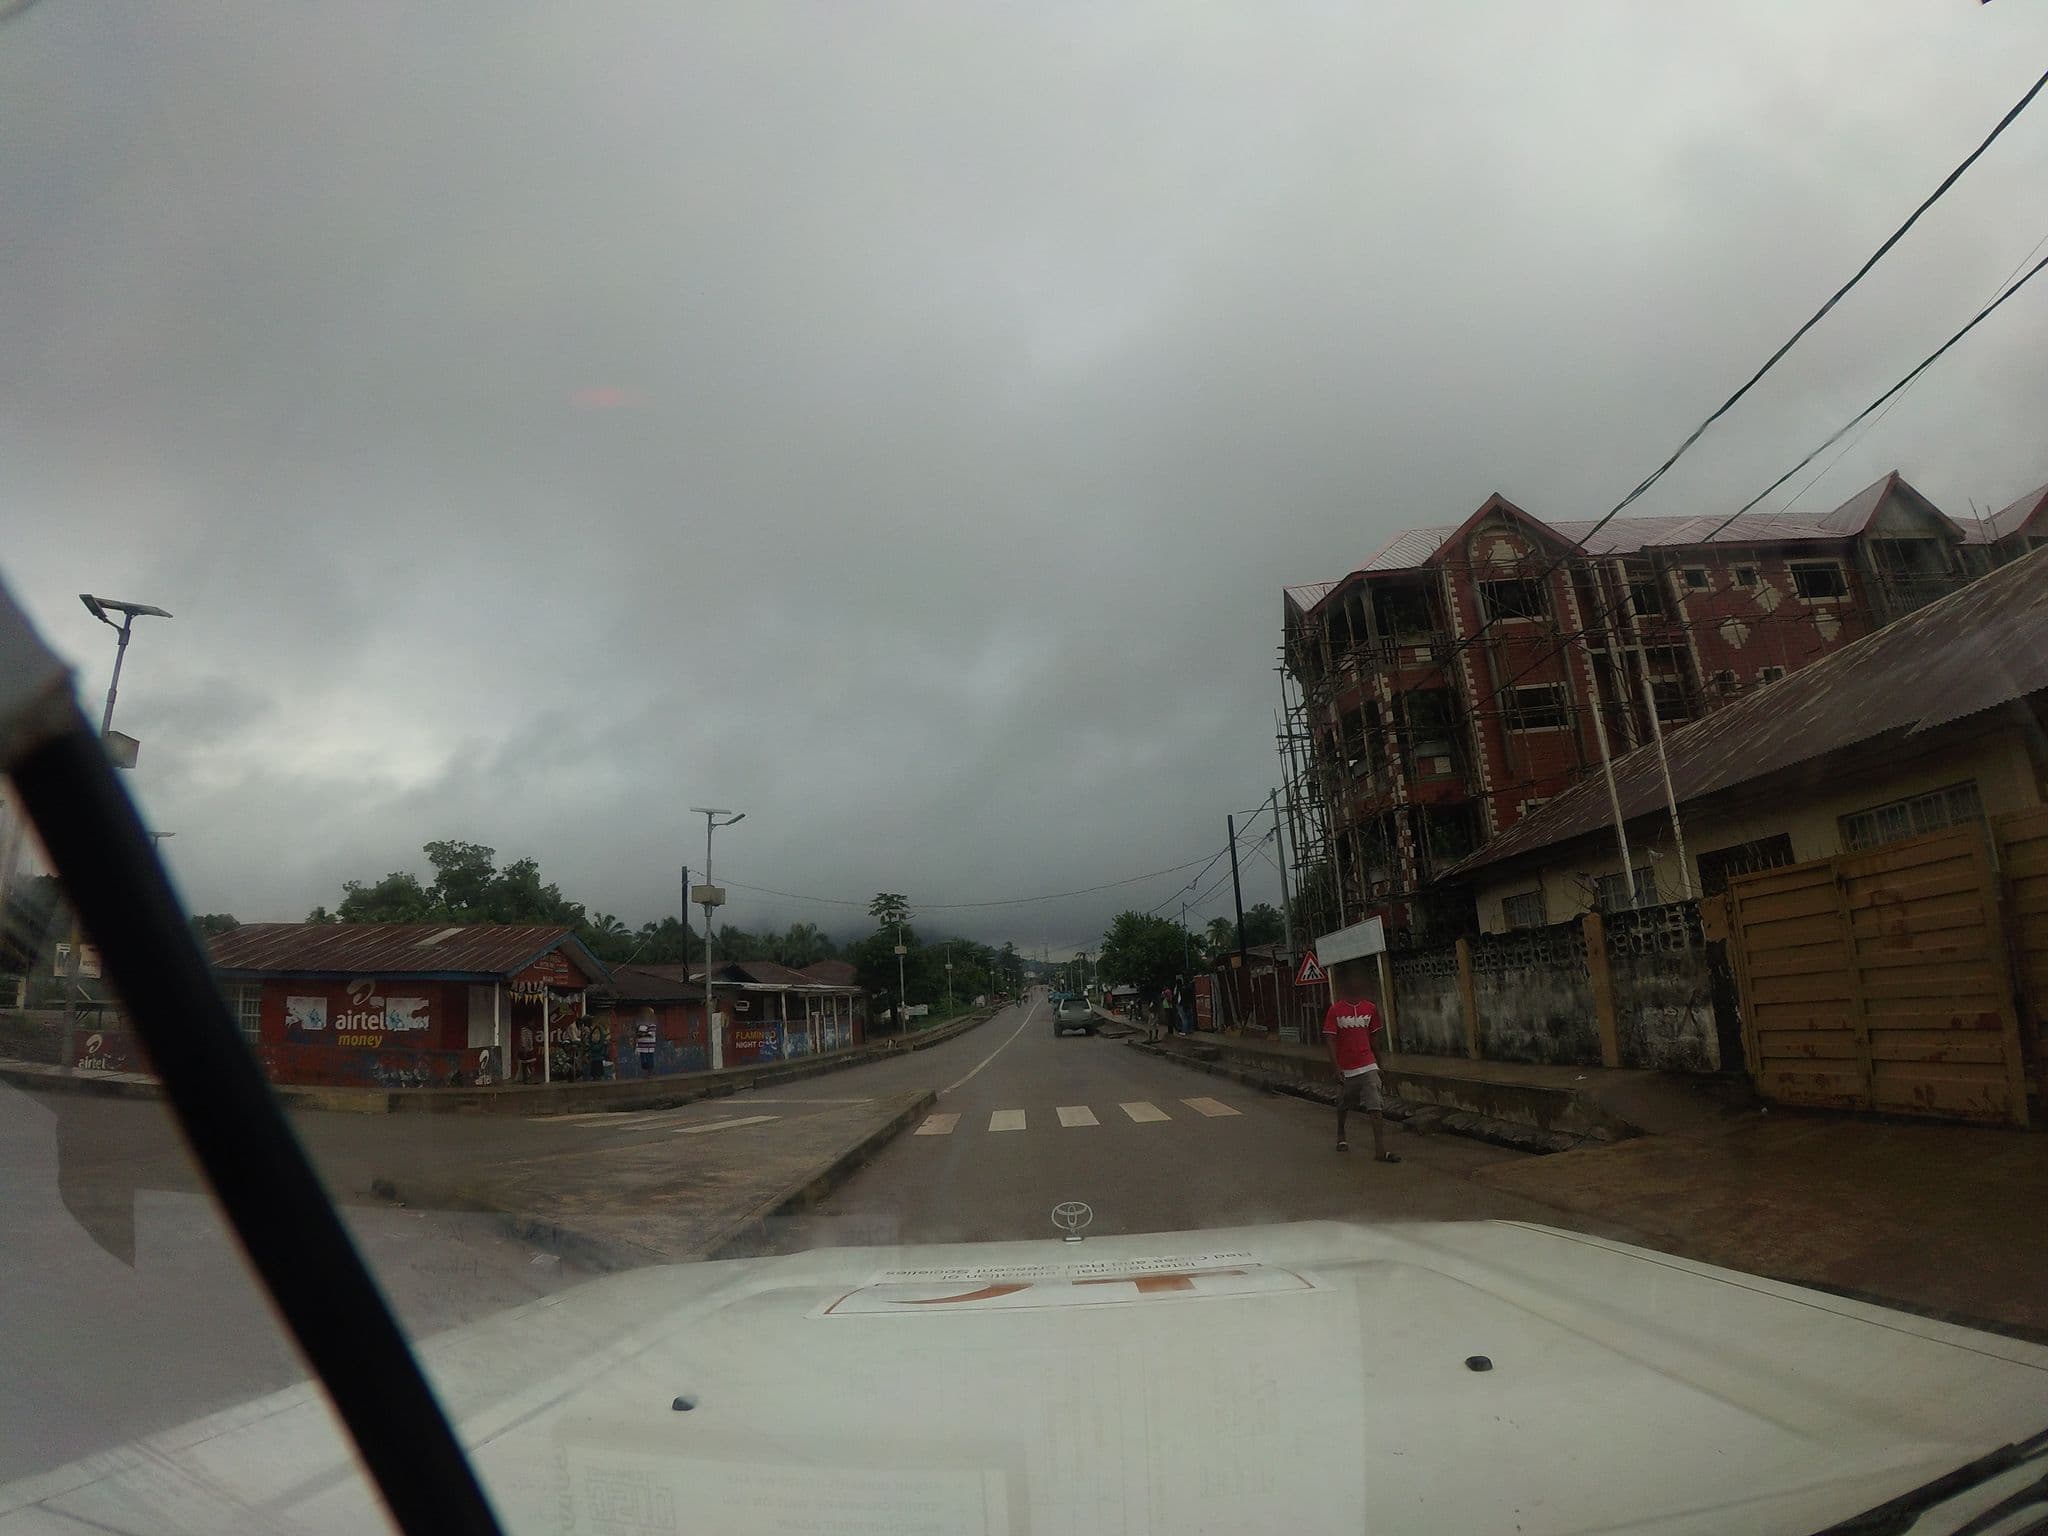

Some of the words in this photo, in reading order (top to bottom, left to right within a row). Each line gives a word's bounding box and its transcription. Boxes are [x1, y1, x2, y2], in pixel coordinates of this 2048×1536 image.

[335, 1009, 386, 1031] airtel
[337, 1033, 383, 1048] money
[78, 1056, 106, 1070] airtel
